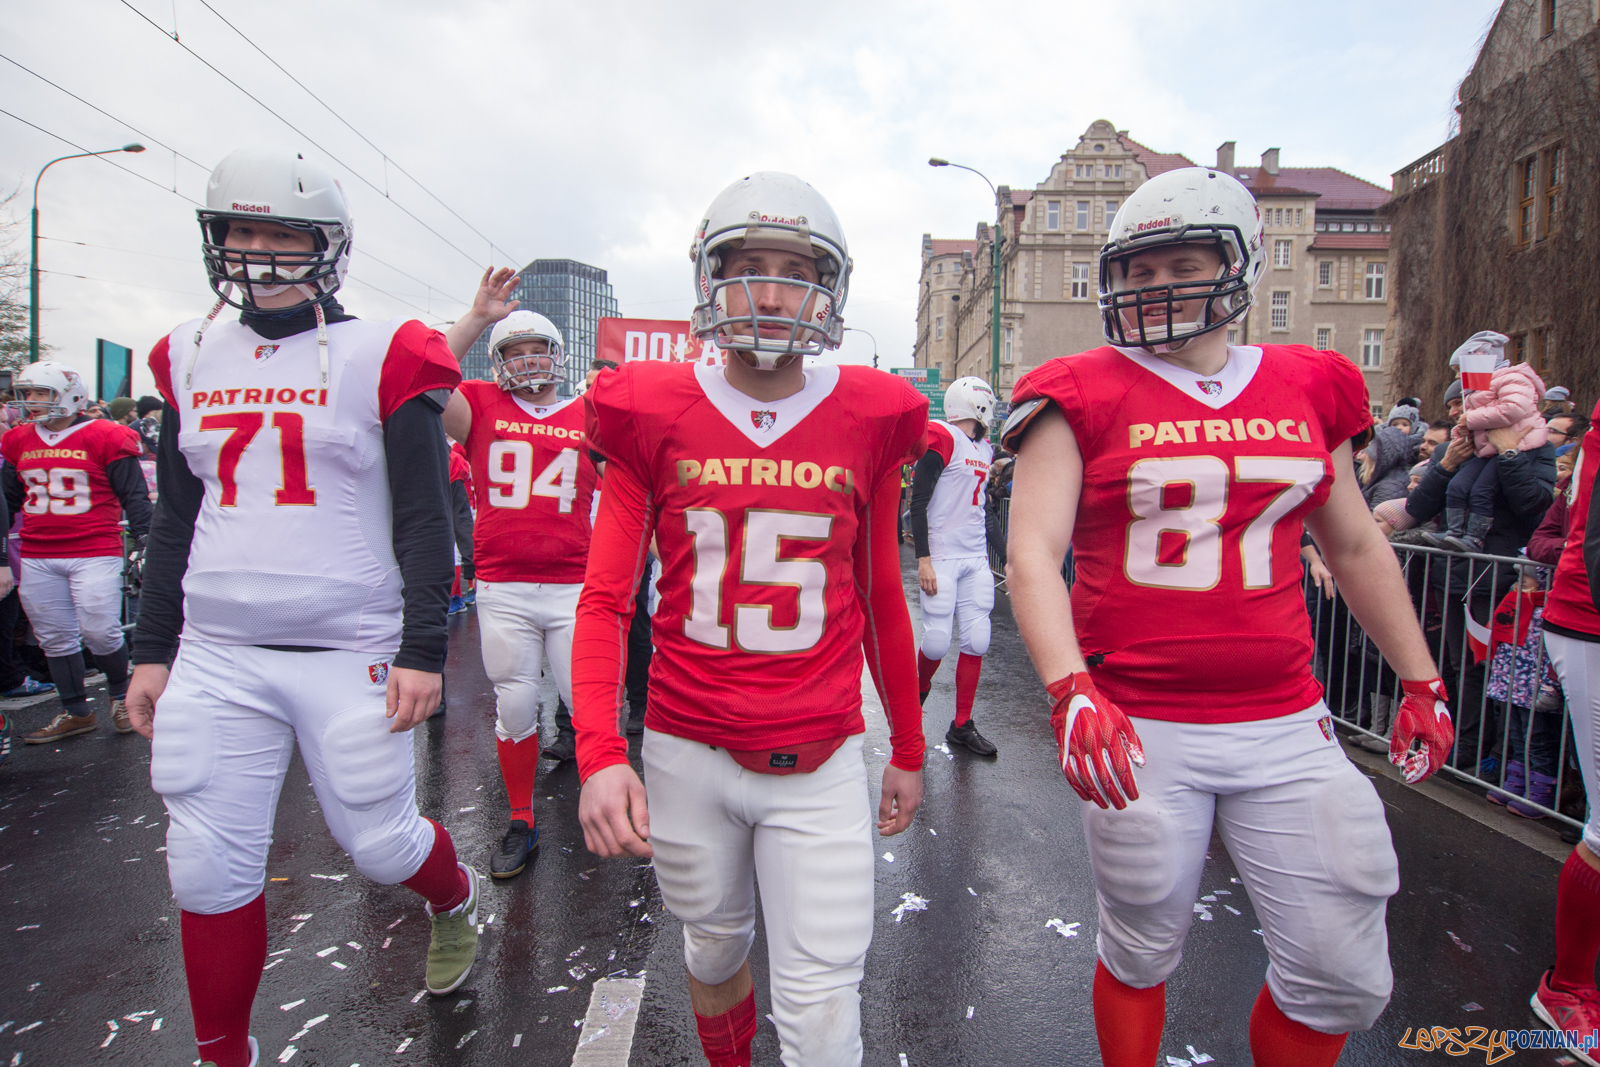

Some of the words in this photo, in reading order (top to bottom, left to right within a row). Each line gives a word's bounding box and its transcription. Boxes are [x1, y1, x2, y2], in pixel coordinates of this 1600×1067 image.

[232, 202, 271, 214] Riddell
[1137, 217, 1171, 232] Riddell
[192, 387, 328, 409] PATRIOCI
[1128, 418, 1312, 449] PATRIOCI
[20, 448, 88, 461] PATRIOCI
[199, 411, 317, 507] 71
[488, 439, 580, 514] 94
[676, 457, 855, 495] PATRIOCI
[1123, 454, 1326, 592] 87
[682, 507, 836, 655] 15
